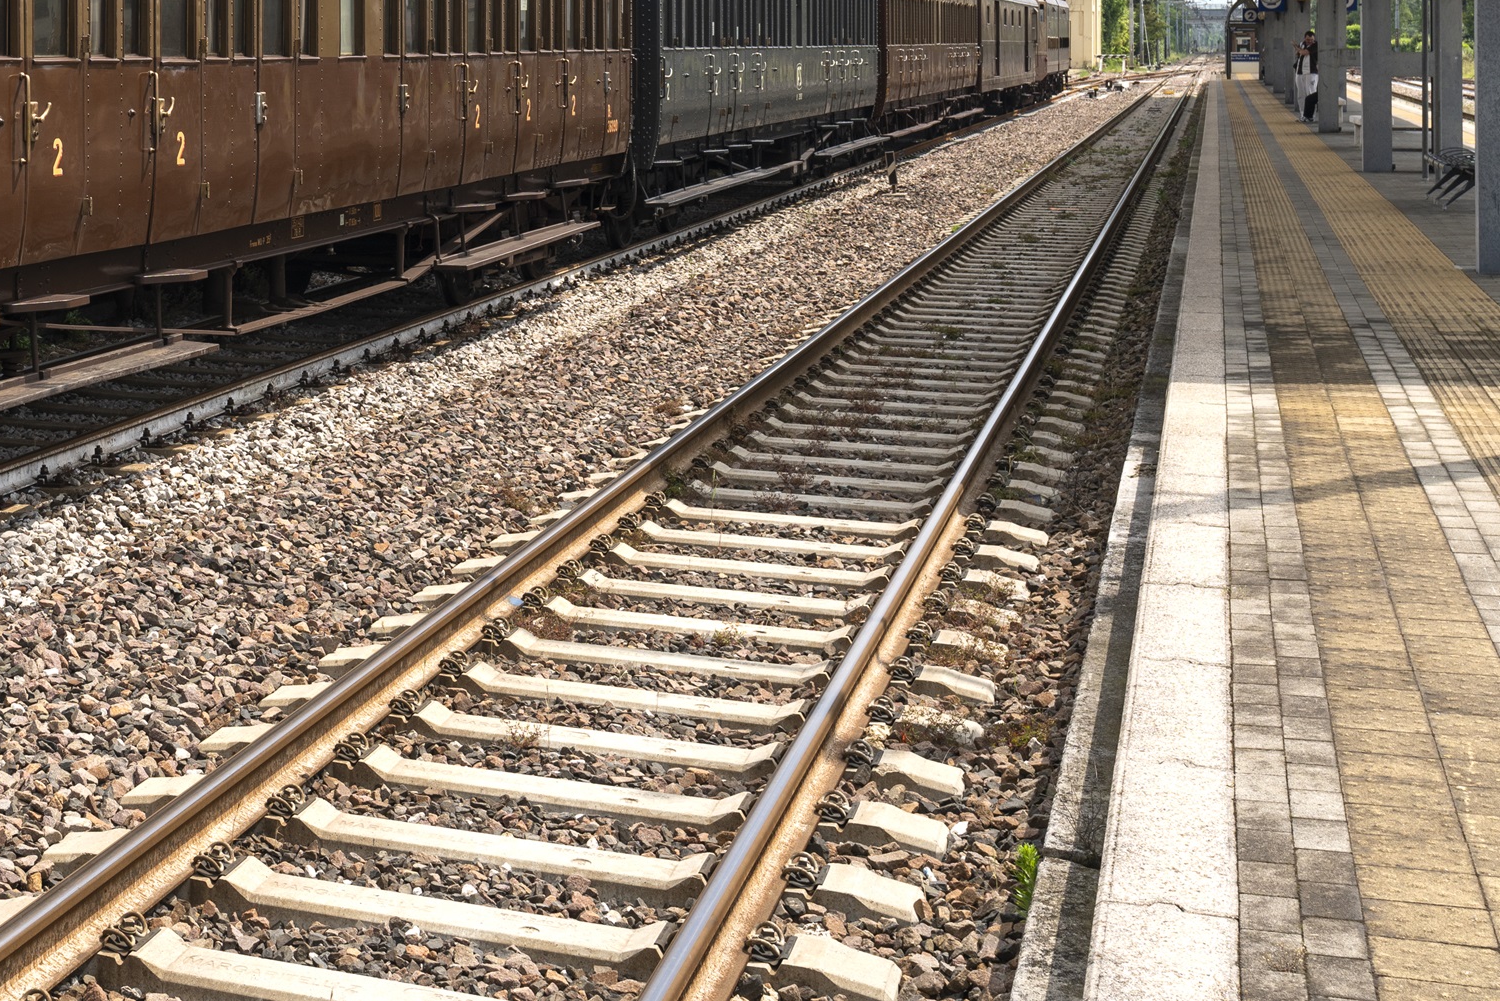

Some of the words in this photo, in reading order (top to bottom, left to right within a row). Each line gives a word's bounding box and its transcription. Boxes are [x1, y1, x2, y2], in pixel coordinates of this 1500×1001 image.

[475, 104, 480, 129] 2
[526, 98, 531, 121] 2
[571, 94, 576, 116] 2
[53, 138, 63, 177] 2
[176, 131, 185, 166] 2
